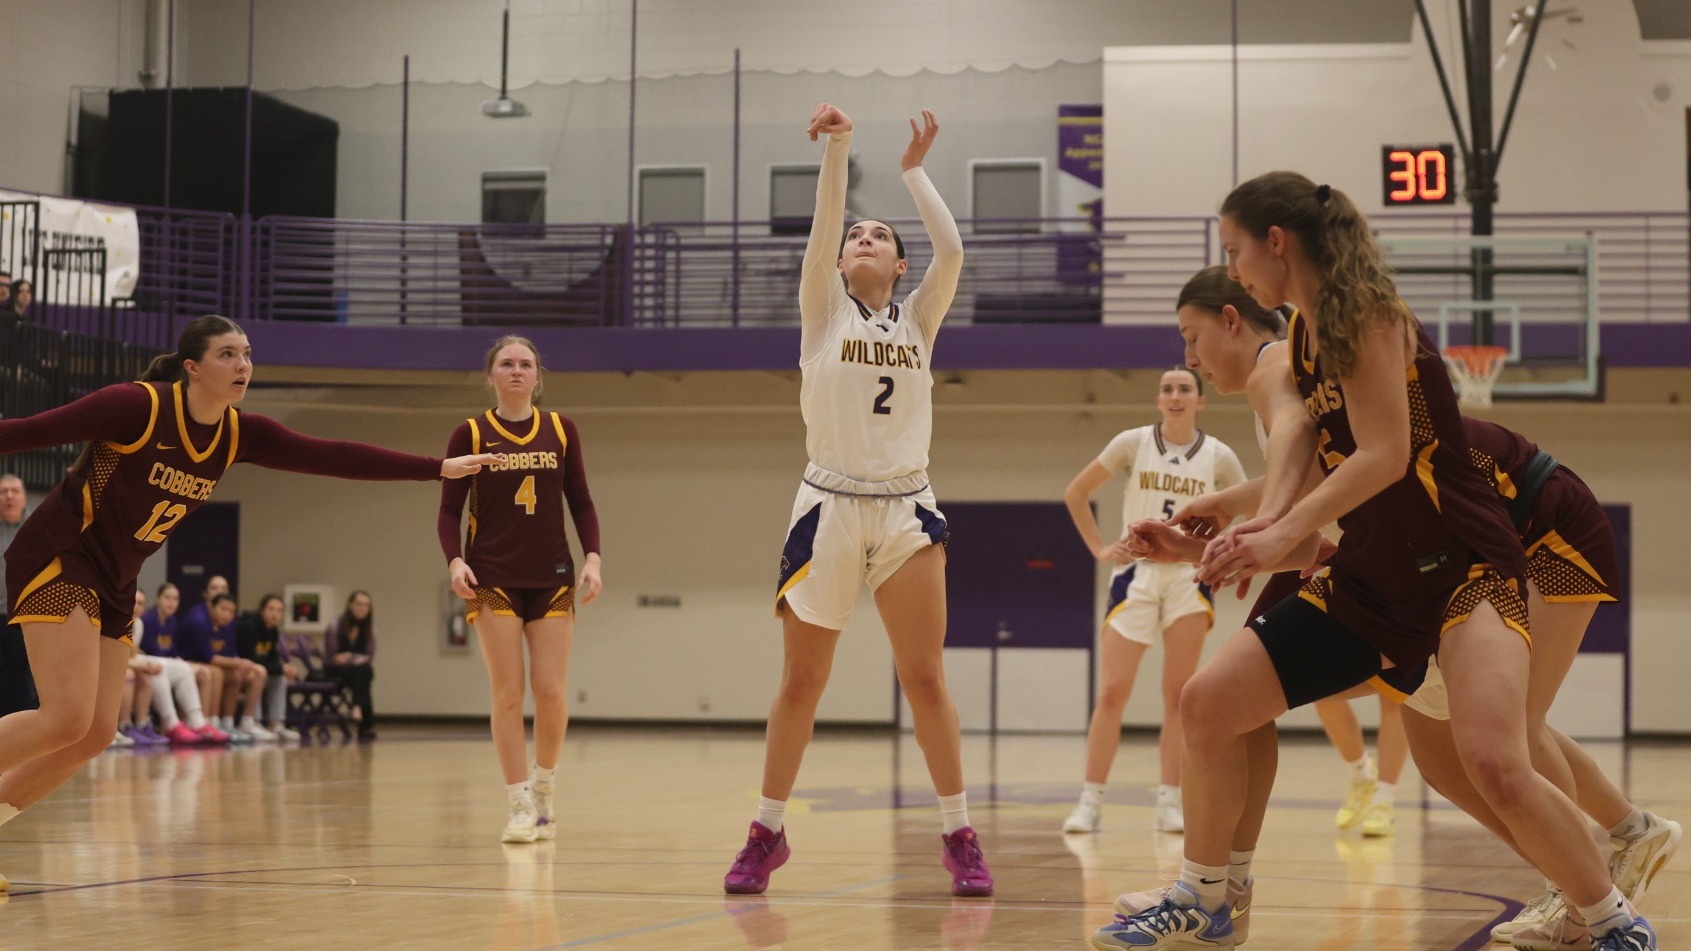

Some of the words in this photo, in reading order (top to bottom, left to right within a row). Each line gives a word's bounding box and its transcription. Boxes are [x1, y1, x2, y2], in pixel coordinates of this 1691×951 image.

[1389, 150, 1447, 201] 30
[841, 338, 921, 370] WILDCATS
[873, 376, 894, 415] 2
[514, 475, 537, 515] 4
[1139, 471, 1206, 497] WILDCATS
[133, 500, 187, 543] 12
[1161, 499, 1176, 522] 5
